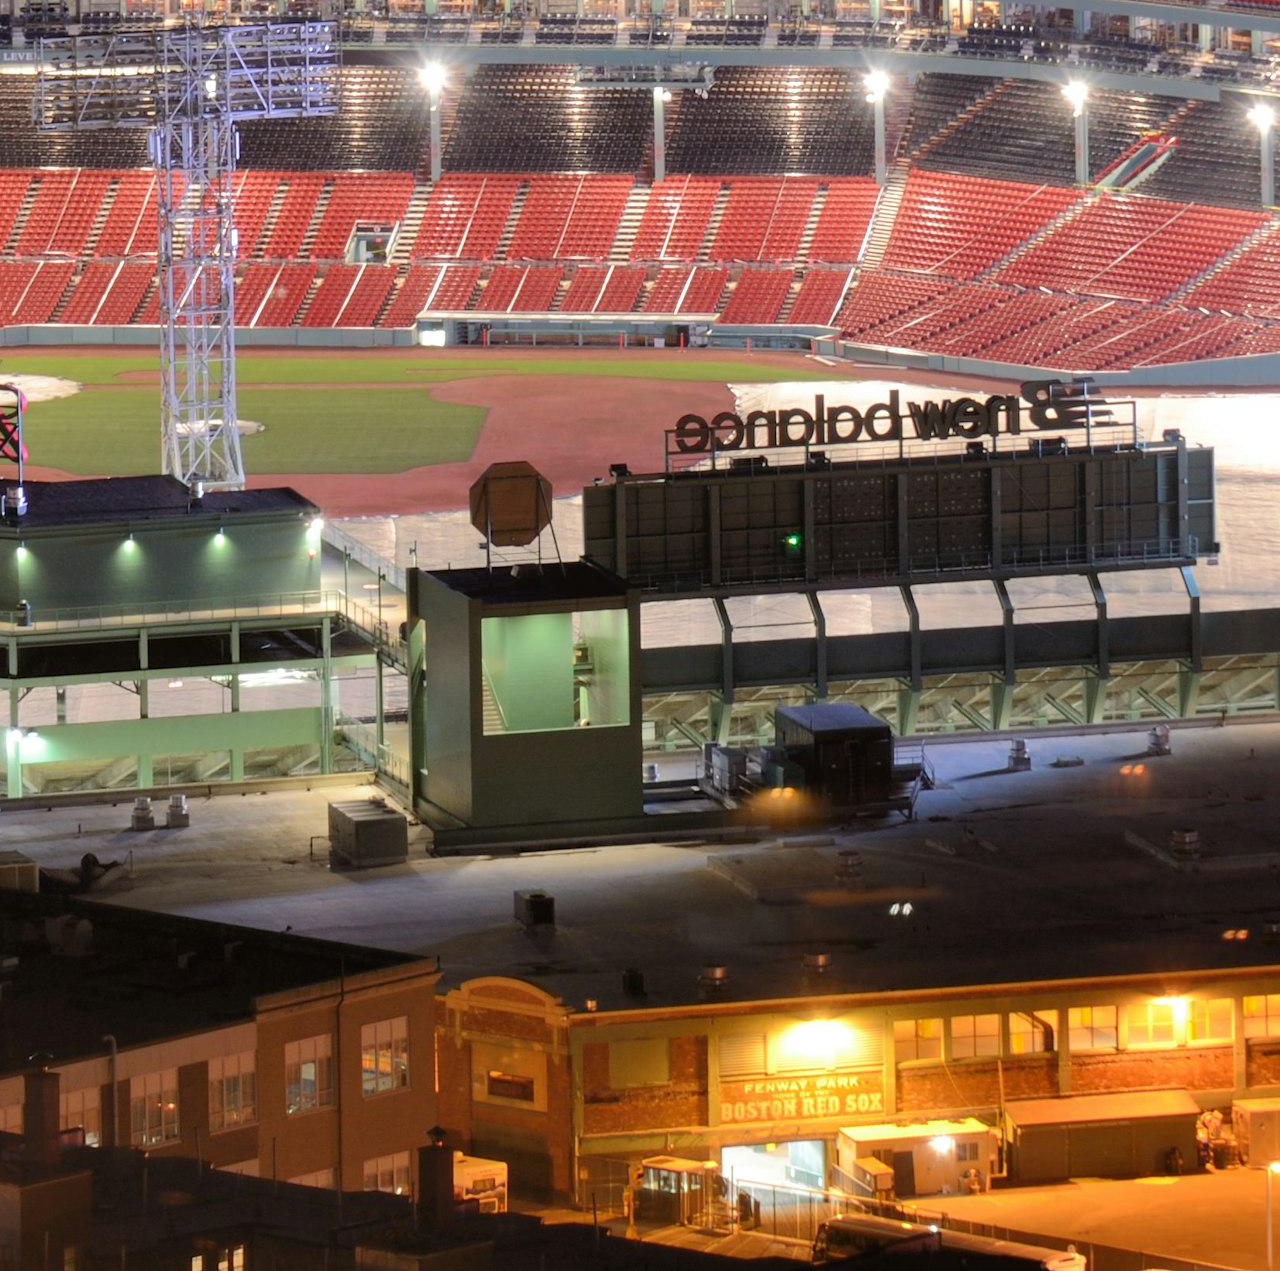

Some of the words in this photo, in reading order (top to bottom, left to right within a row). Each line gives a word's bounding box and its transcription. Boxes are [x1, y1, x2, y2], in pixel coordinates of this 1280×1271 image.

[744, 1079, 809, 1094] FENWAY
[816, 1076, 860, 1089] PARK
[721, 1098, 797, 1122] BOSTON
[802, 1095, 840, 1117] RED
[845, 1092, 883, 1113] SOX
